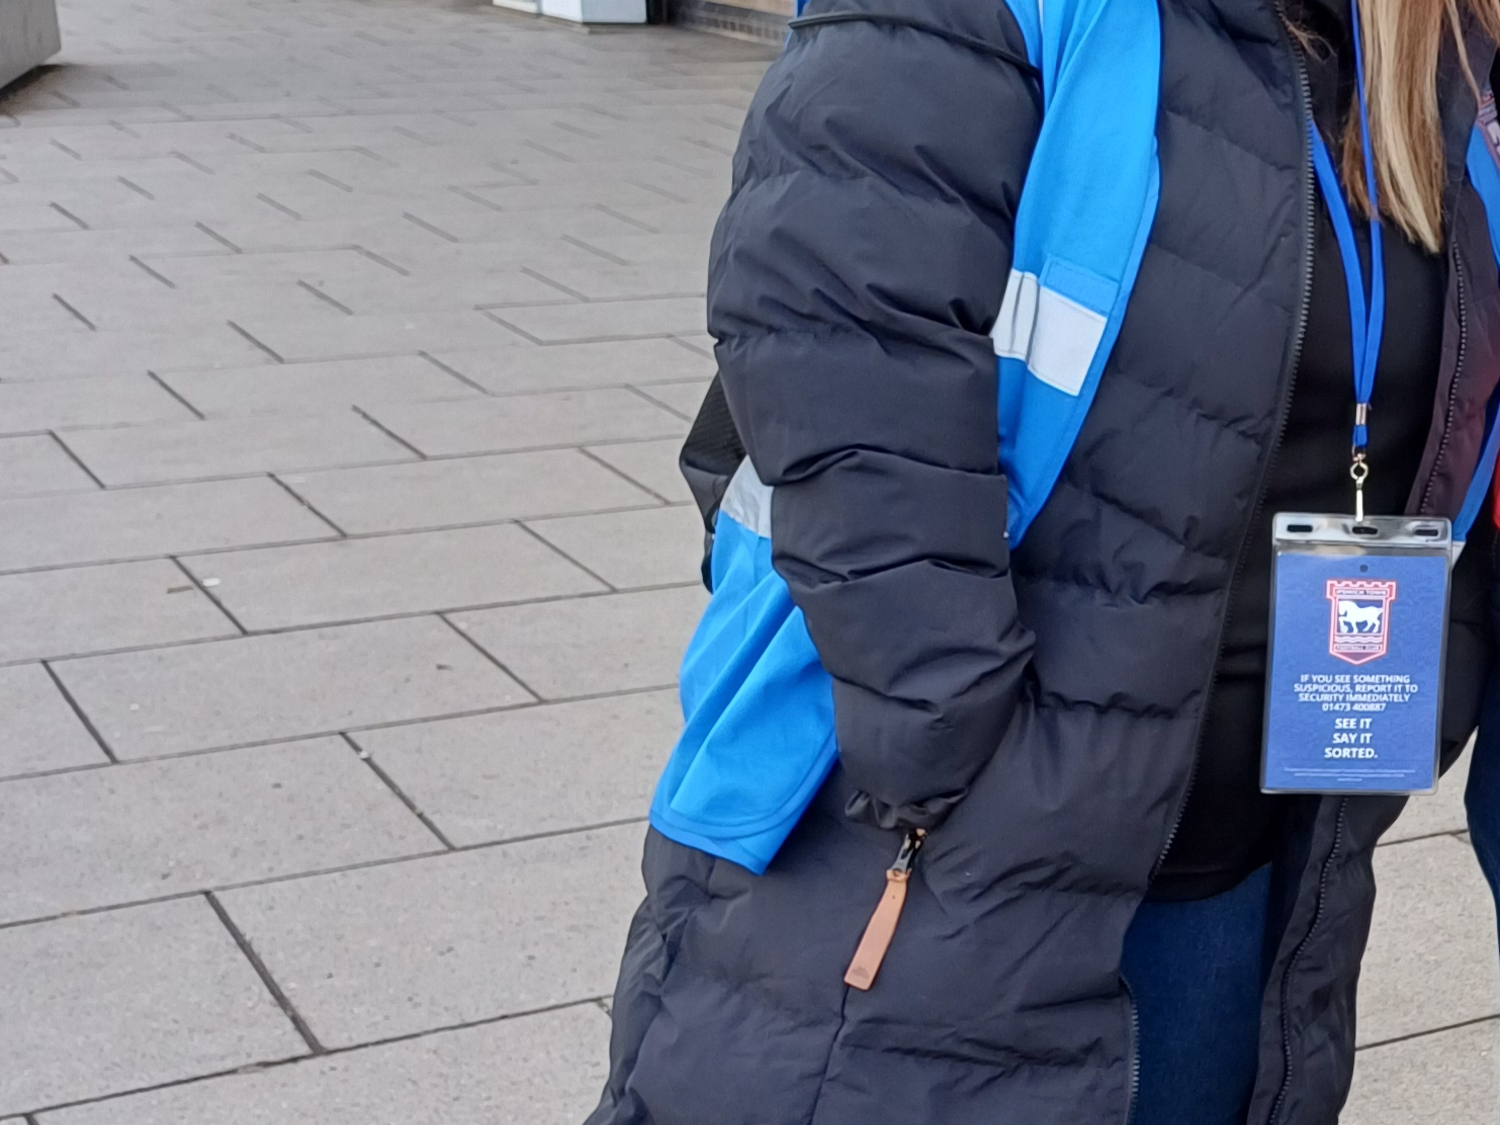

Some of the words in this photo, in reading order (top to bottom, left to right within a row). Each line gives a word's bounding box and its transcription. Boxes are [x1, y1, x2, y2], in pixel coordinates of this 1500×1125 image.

[1300, 674, 1310, 683] IF
[1311, 674, 1333, 683] YOU
[1334, 675, 1351, 683] SEE
[1353, 674, 1411, 684] SOMETHING
[1294, 683, 1353, 694] SUSPICIOUS,
[1355, 683, 1392, 693] REPORT
[1394, 684, 1403, 693] IT
[1405, 684, 1419, 693] TO
[1298, 693, 1345, 702] SECURITY
[1345, 694, 1411, 703] IMMEDIATELY
[1321, 703, 1351, 711] 01473
[1334, 718, 1357, 729] SEE
[1360, 718, 1373, 729] IT
[1332, 733, 1358, 744] SAY
[1360, 733, 1373, 744] IT
[1324, 747, 1379, 759] SORTED.
